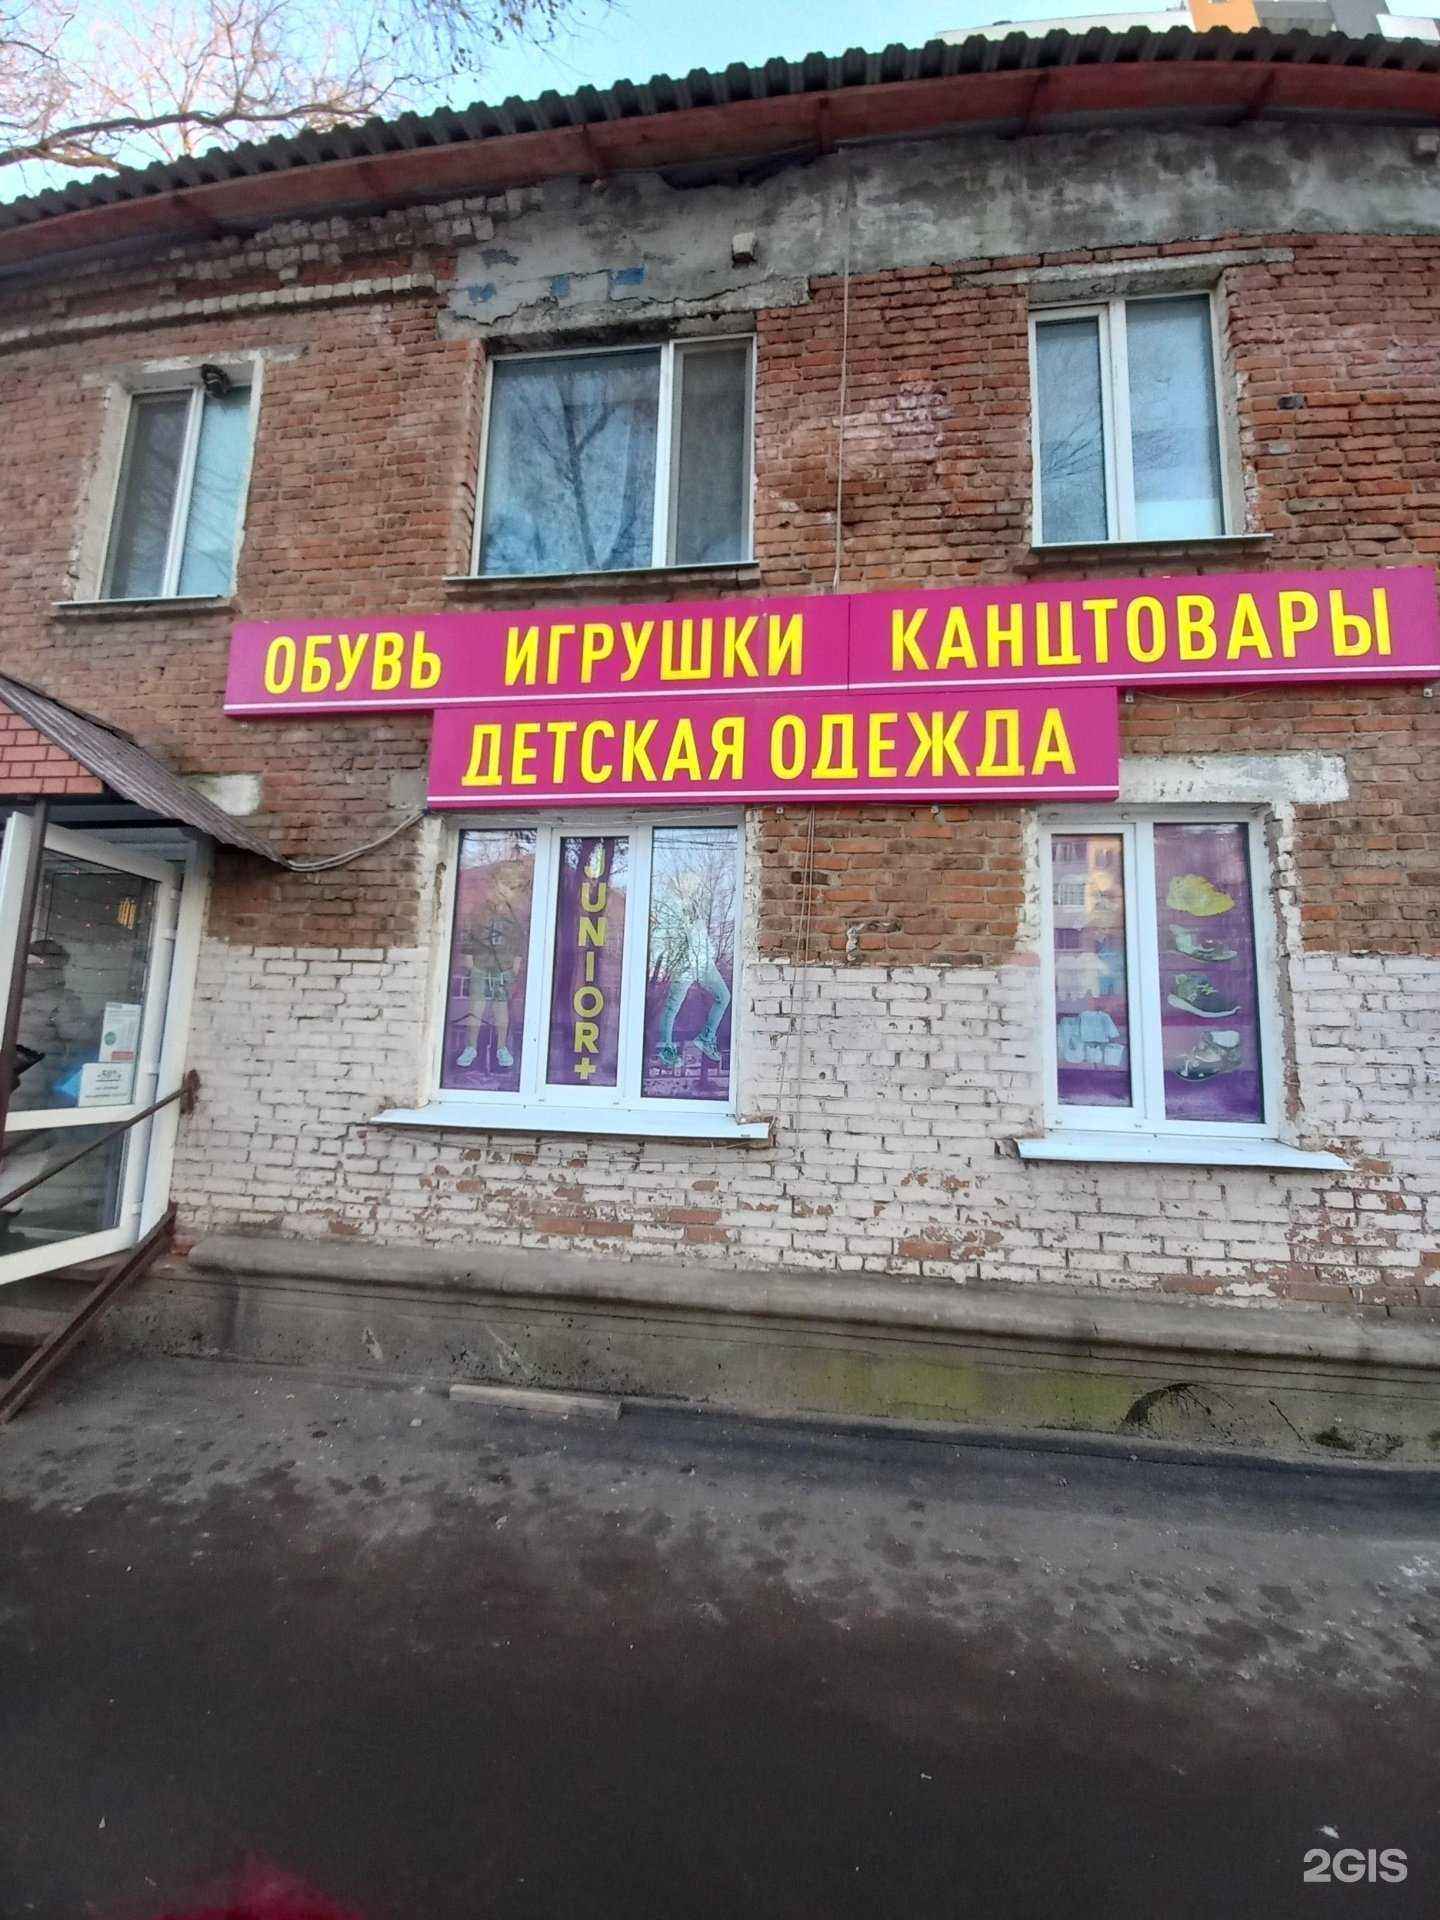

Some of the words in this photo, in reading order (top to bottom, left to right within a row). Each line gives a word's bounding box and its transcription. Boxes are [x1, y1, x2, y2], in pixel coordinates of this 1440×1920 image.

[264, 631, 443, 694] ОБУВЬ
[505, 614, 803, 686] ИГРУШКИ
[892, 588, 1392, 671] КАНЦТОВАРЫ
[462, 716, 745, 786] ДЕТСКАЯ
[769, 708, 1077, 782] ОДЕЖДА
